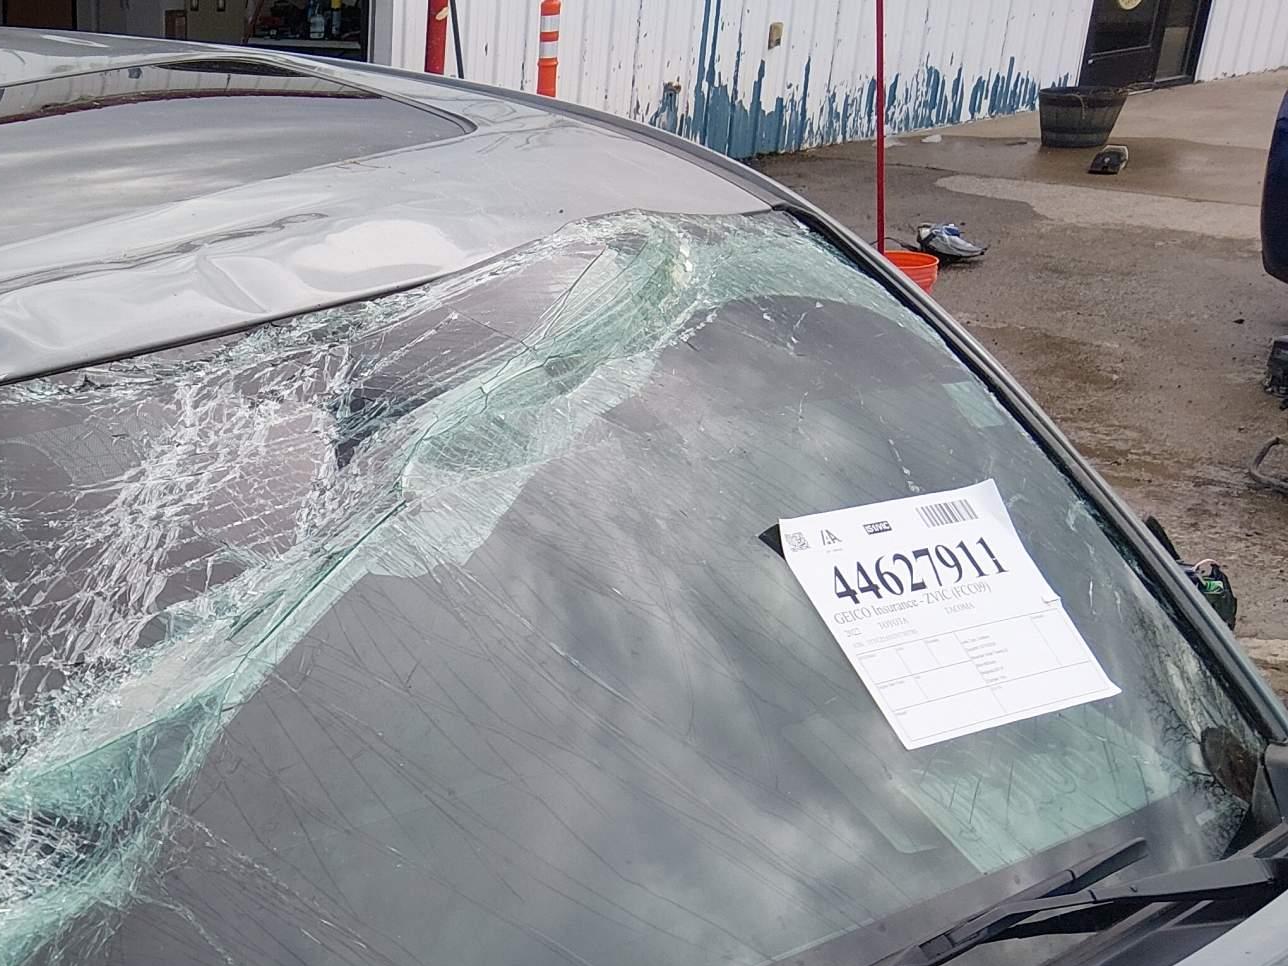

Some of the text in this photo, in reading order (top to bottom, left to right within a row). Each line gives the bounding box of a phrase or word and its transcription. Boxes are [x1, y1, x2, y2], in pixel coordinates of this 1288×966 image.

[834, 537, 1008, 604] 44627911
[833, 607, 872, 625] GEICO
[873, 599, 918, 616] Insurance
